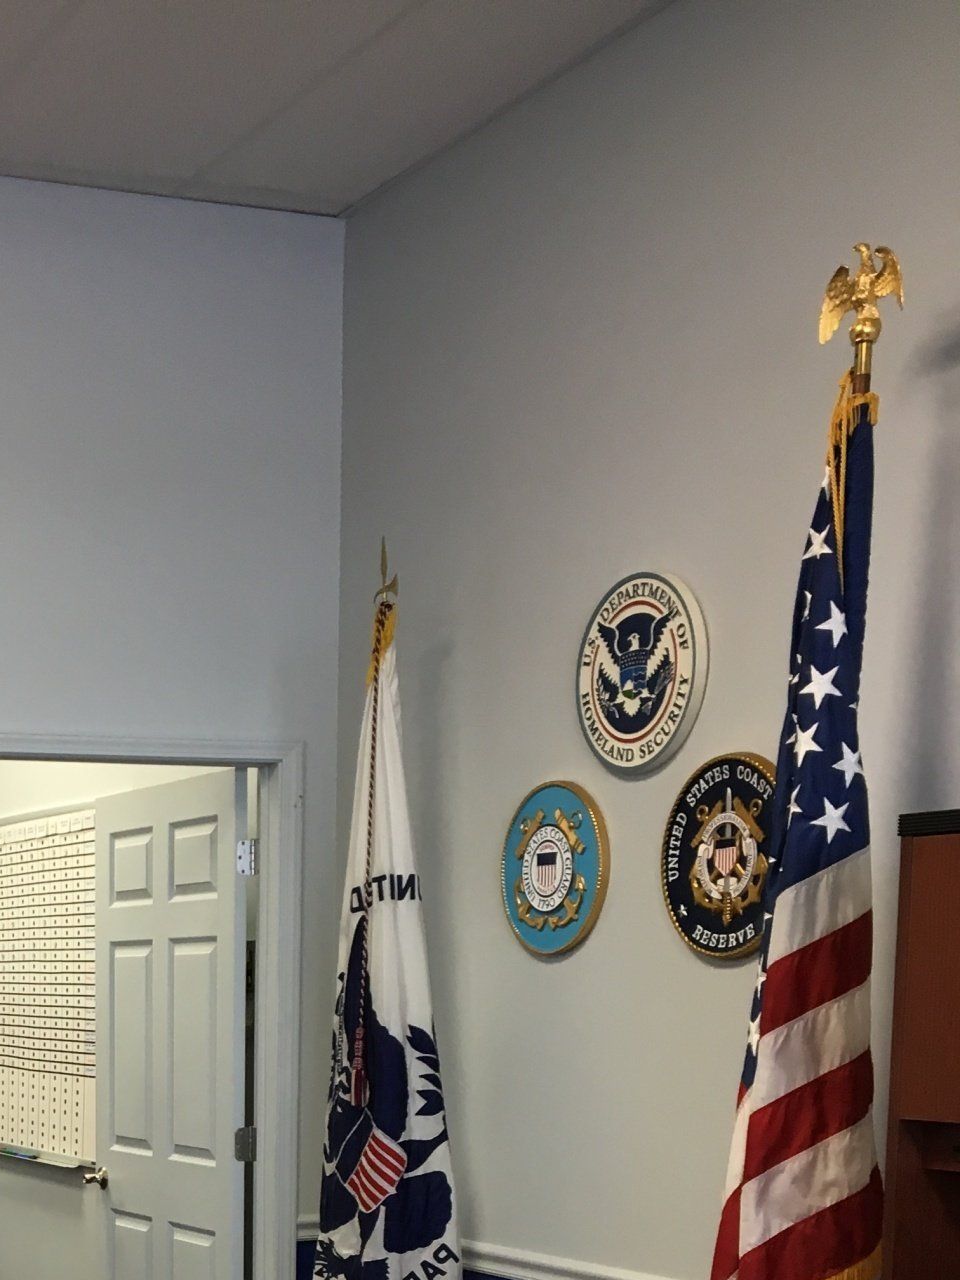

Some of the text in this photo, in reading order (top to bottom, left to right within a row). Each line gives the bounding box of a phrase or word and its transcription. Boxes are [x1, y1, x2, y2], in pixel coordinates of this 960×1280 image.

[582, 582, 690, 667] U.S. DEPARTMENT OF
[581, 674, 690, 762] HOMELAND SECURITY
[527, 828, 548, 857] STATES
[549, 828, 569, 854] COAST
[668, 812, 688, 882] UNITED
[687, 765, 730, 807] STATES
[737, 765, 773, 800] COAST
[557, 857, 572, 898] GUARD
[692, 923, 756, 948] RESERVE
